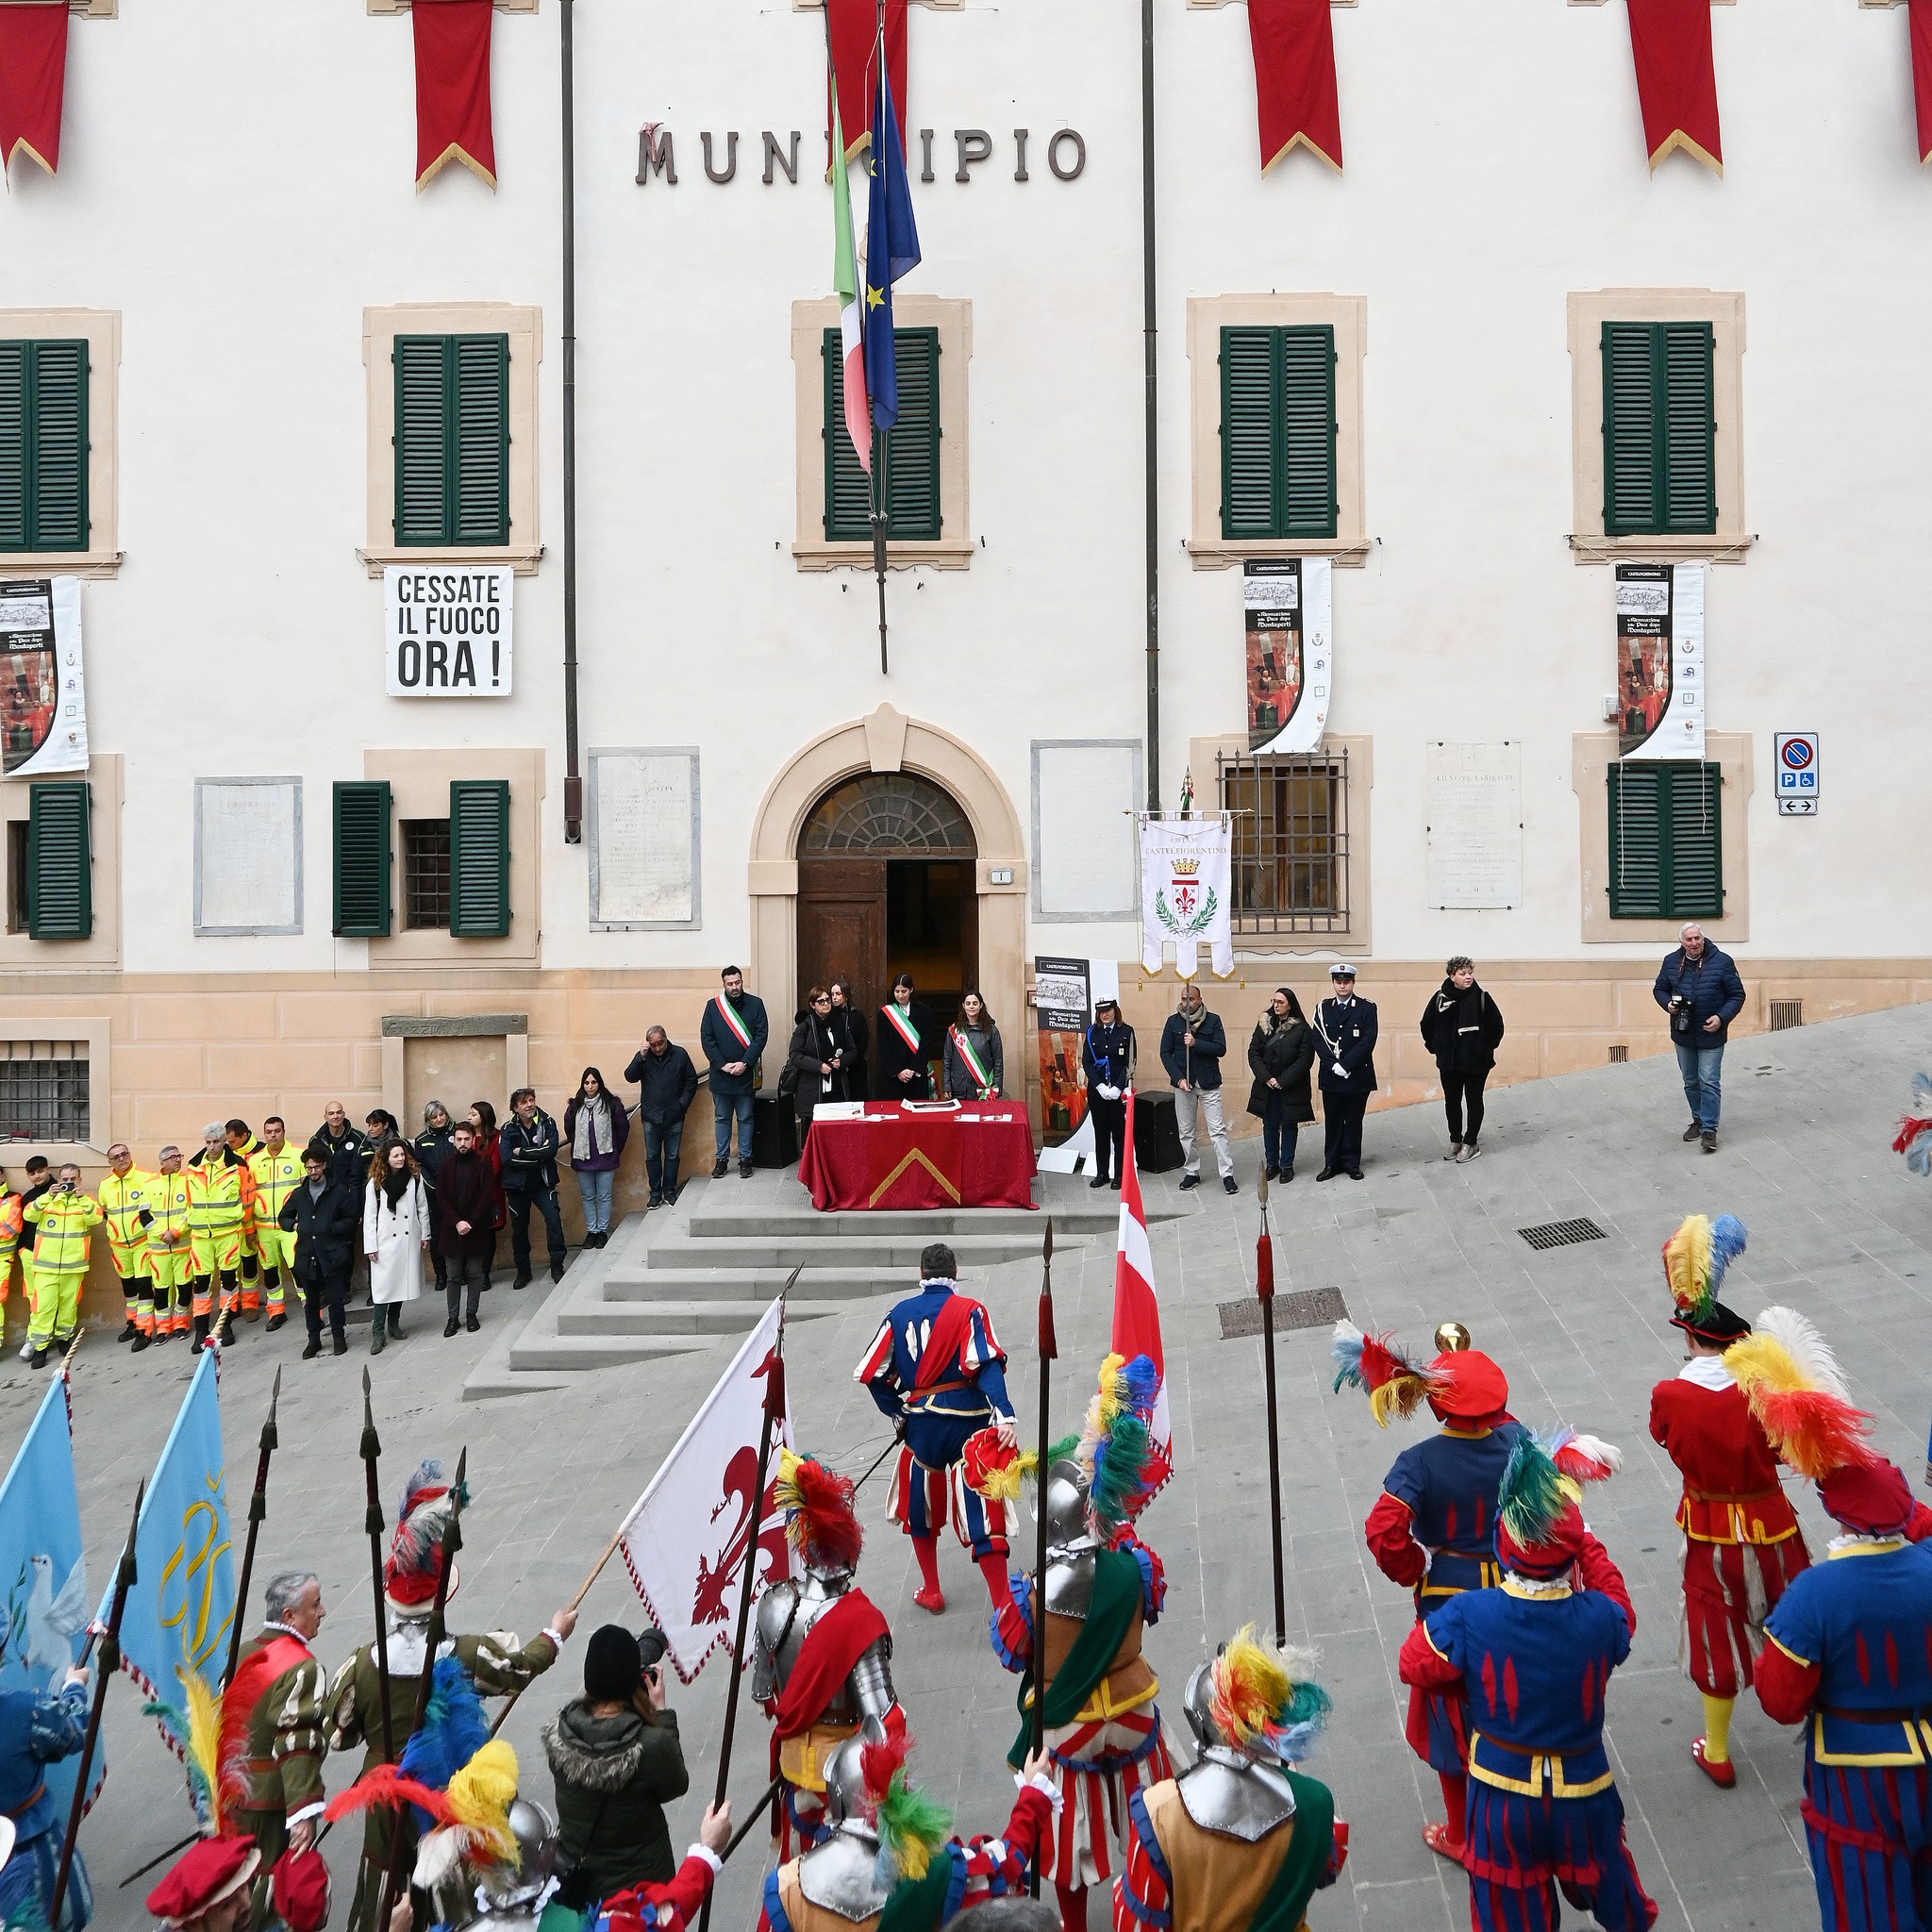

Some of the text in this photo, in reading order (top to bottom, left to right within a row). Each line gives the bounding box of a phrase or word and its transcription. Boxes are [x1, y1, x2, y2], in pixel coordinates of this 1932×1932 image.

[635, 127, 1086, 184] MUNIPIO
[398, 575, 500, 603] CESSATE
[398, 607, 500, 635] IL FUOCO
[398, 640, 476, 688] ORA
[1785, 774, 1793, 786] P
